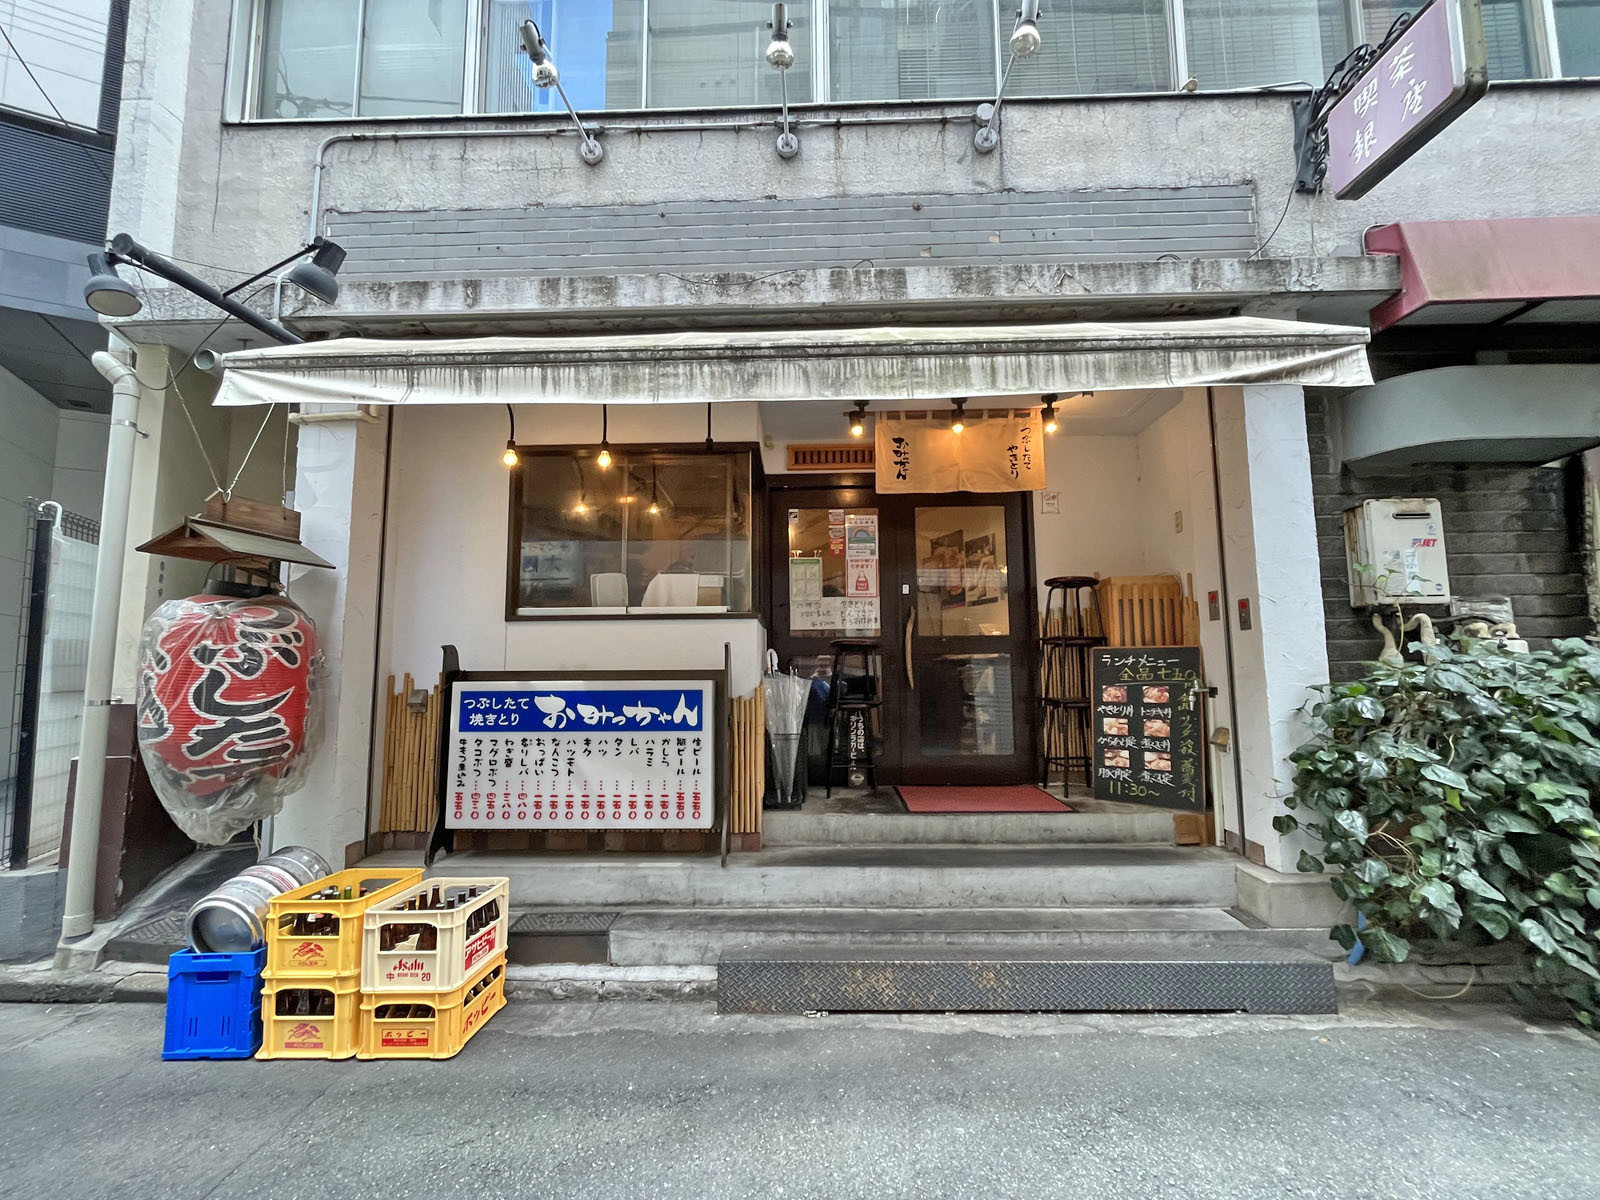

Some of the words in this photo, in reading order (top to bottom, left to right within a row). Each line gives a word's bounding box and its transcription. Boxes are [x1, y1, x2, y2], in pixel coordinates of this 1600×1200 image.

[1353, 41, 1415, 118] 喫茶
[1006, 445, 1019, 480] やきとり
[1020, 427, 1032, 470] つぶしたて
[1101, 654, 1179, 667] ランチメニュー
[463, 697, 530, 710] つぶしたて
[533, 692, 698, 729] おみっちゃん
[468, 713, 520, 726] 焼きとり
[551, 737, 561, 777] なんこつ
[566, 739, 577, 777] ハツモト
[598, 739, 608, 757] ハツ
[614, 737, 623, 757] タン
[629, 737, 640, 755] レバ
[645, 739, 655, 767] ハラミ
[661, 738, 671, 767] かしら
[676, 737, 686, 776] 瓶ビール
[692, 737, 702, 776] 生ビール
[465, 928, 496, 960] アサヒビール
[386, 972, 395, 982] 中
[393, 958, 424, 971] Asahi
[421, 972, 431, 982] 20
[462, 991, 497, 1034] ホッピー
[384, 1030, 427, 1038] ホッピー
